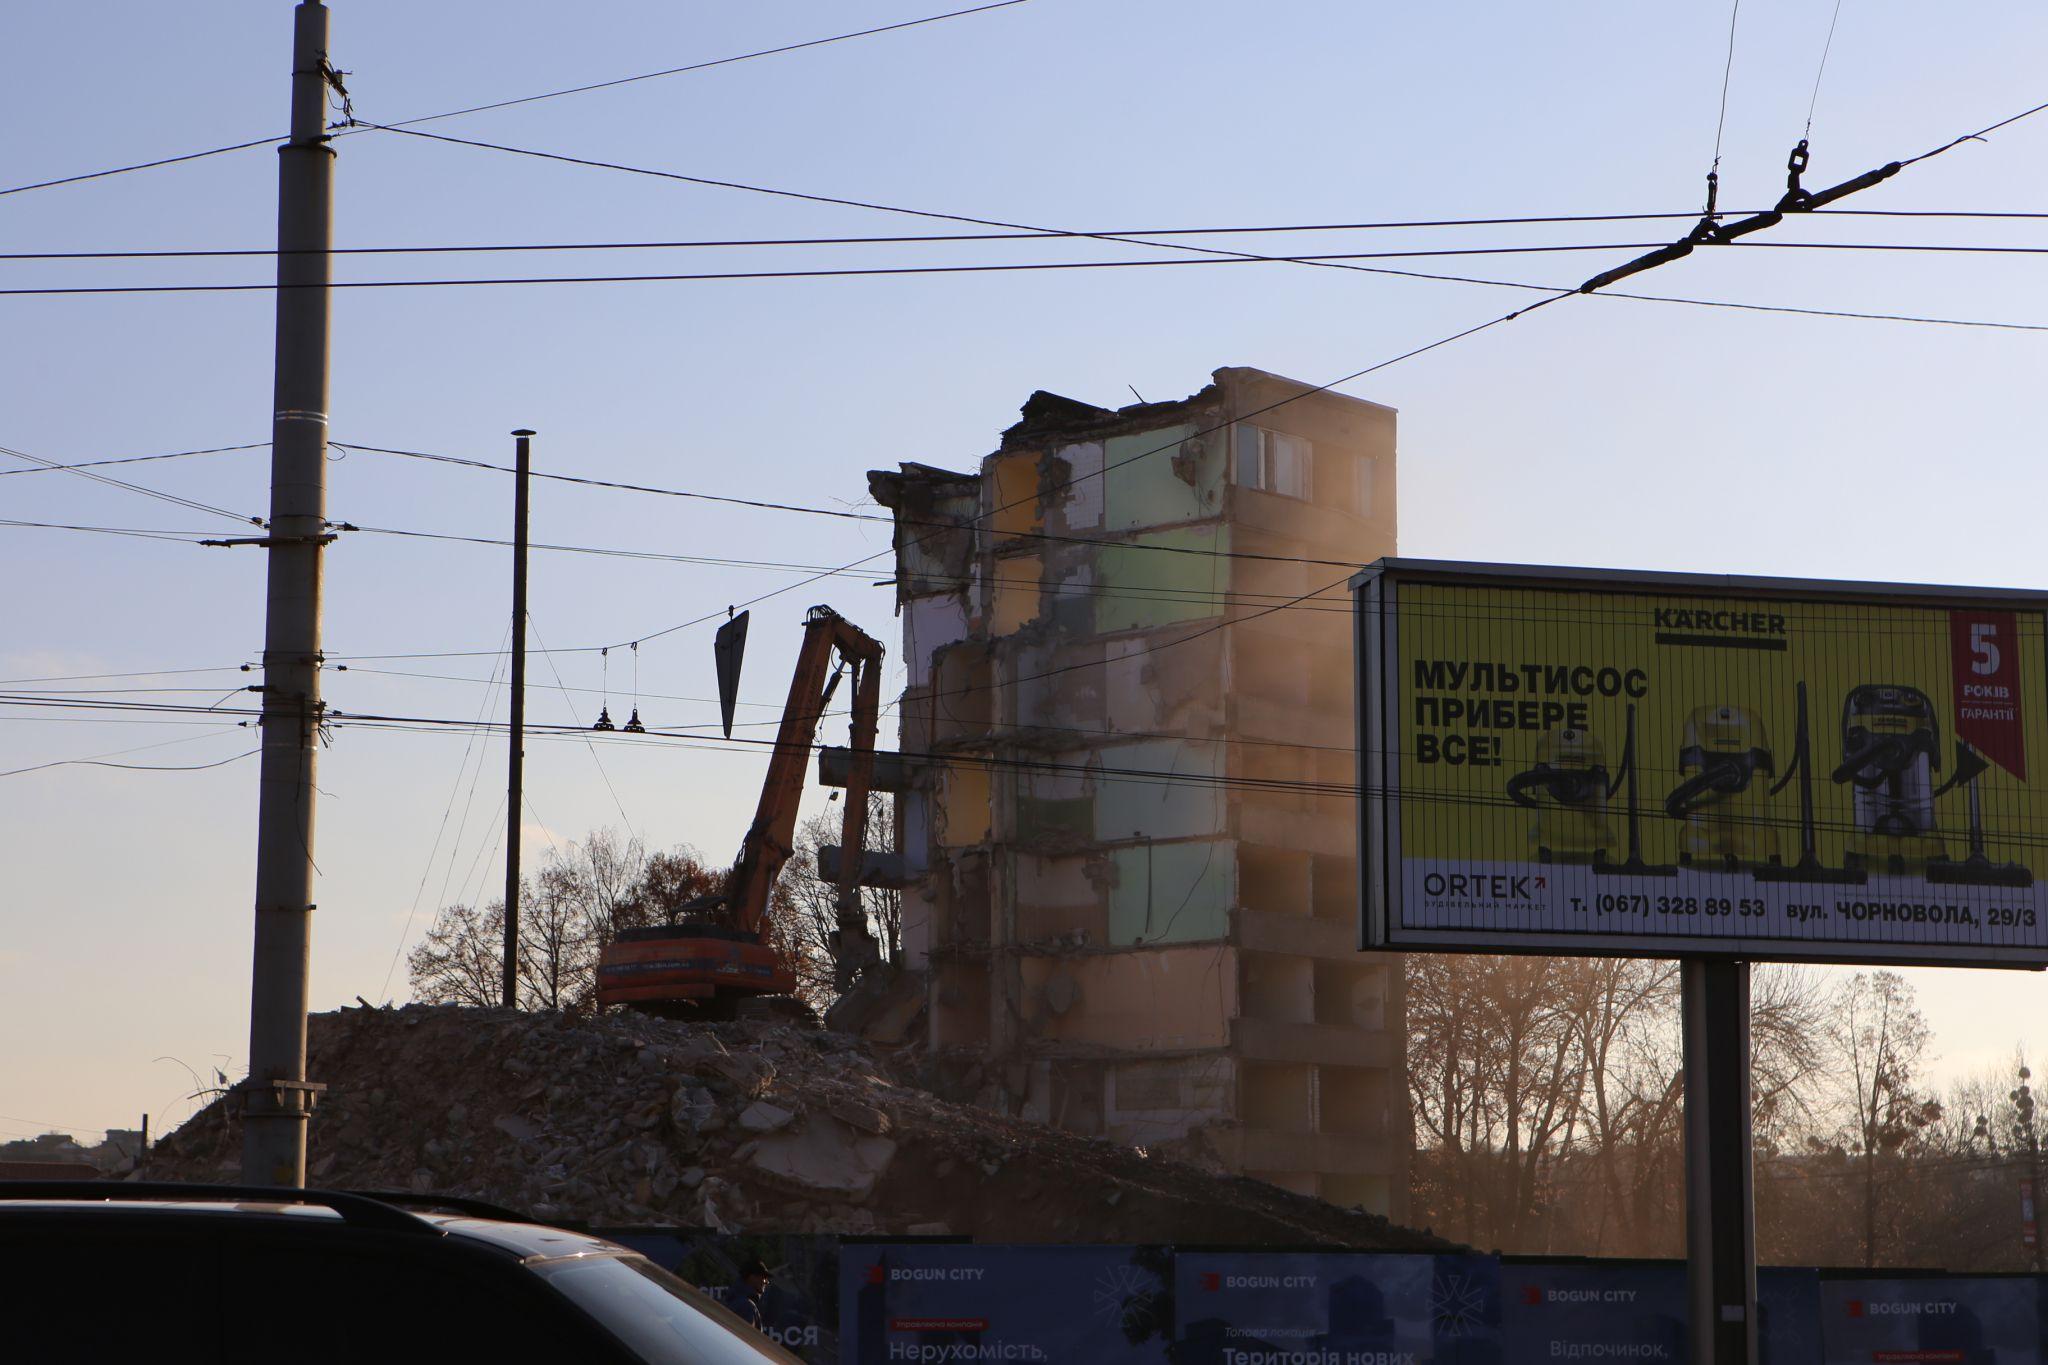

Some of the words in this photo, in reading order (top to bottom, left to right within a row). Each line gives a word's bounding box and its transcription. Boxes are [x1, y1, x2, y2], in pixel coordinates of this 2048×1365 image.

[1654, 608, 1786, 634] KÄRCHER
[1970, 623, 2000, 676] 5
[1415, 660, 1648, 698] МУЛЬТИСОС
[1964, 685, 2009, 698] РОКІВ
[1416, 697, 1588, 731] ПРИБЕРЕ
[1961, 706, 2014, 720] ГАРАНТІЇ
[1416, 733, 1501, 766] ВСЕ!
[1424, 873, 1531, 899] ORTEK
[1570, 897, 1588, 912] т.
[1596, 894, 1649, 917] (067)
[1657, 896, 1698, 915] 328
[1705, 897, 1731, 916] 89
[1739, 899, 1765, 917] 53
[1787, 904, 1828, 922] вул.
[1836, 901, 1980, 928] ЧОРНОВОЛА,
[1987, 908, 2036, 927] 29/3
[891, 1269, 945, 1280] BOGUN
[950, 1268, 984, 1280] CITY
[1226, 1276, 1279, 1288] BOGUN
[1284, 1276, 1317, 1288] CITY
[1548, 1290, 1600, 1301] BOGUN
[1604, 1290, 1637, 1301] CITY
[1870, 1303, 1921, 1314] BOGUN
[1925, 1302, 1957, 1314] CITY
[889, 1339, 1048, 1365] Нерухомість,
[1222, 1347, 1341, 1365] Територія
[1550, 1340, 1669, 1360] Відпочинок,
